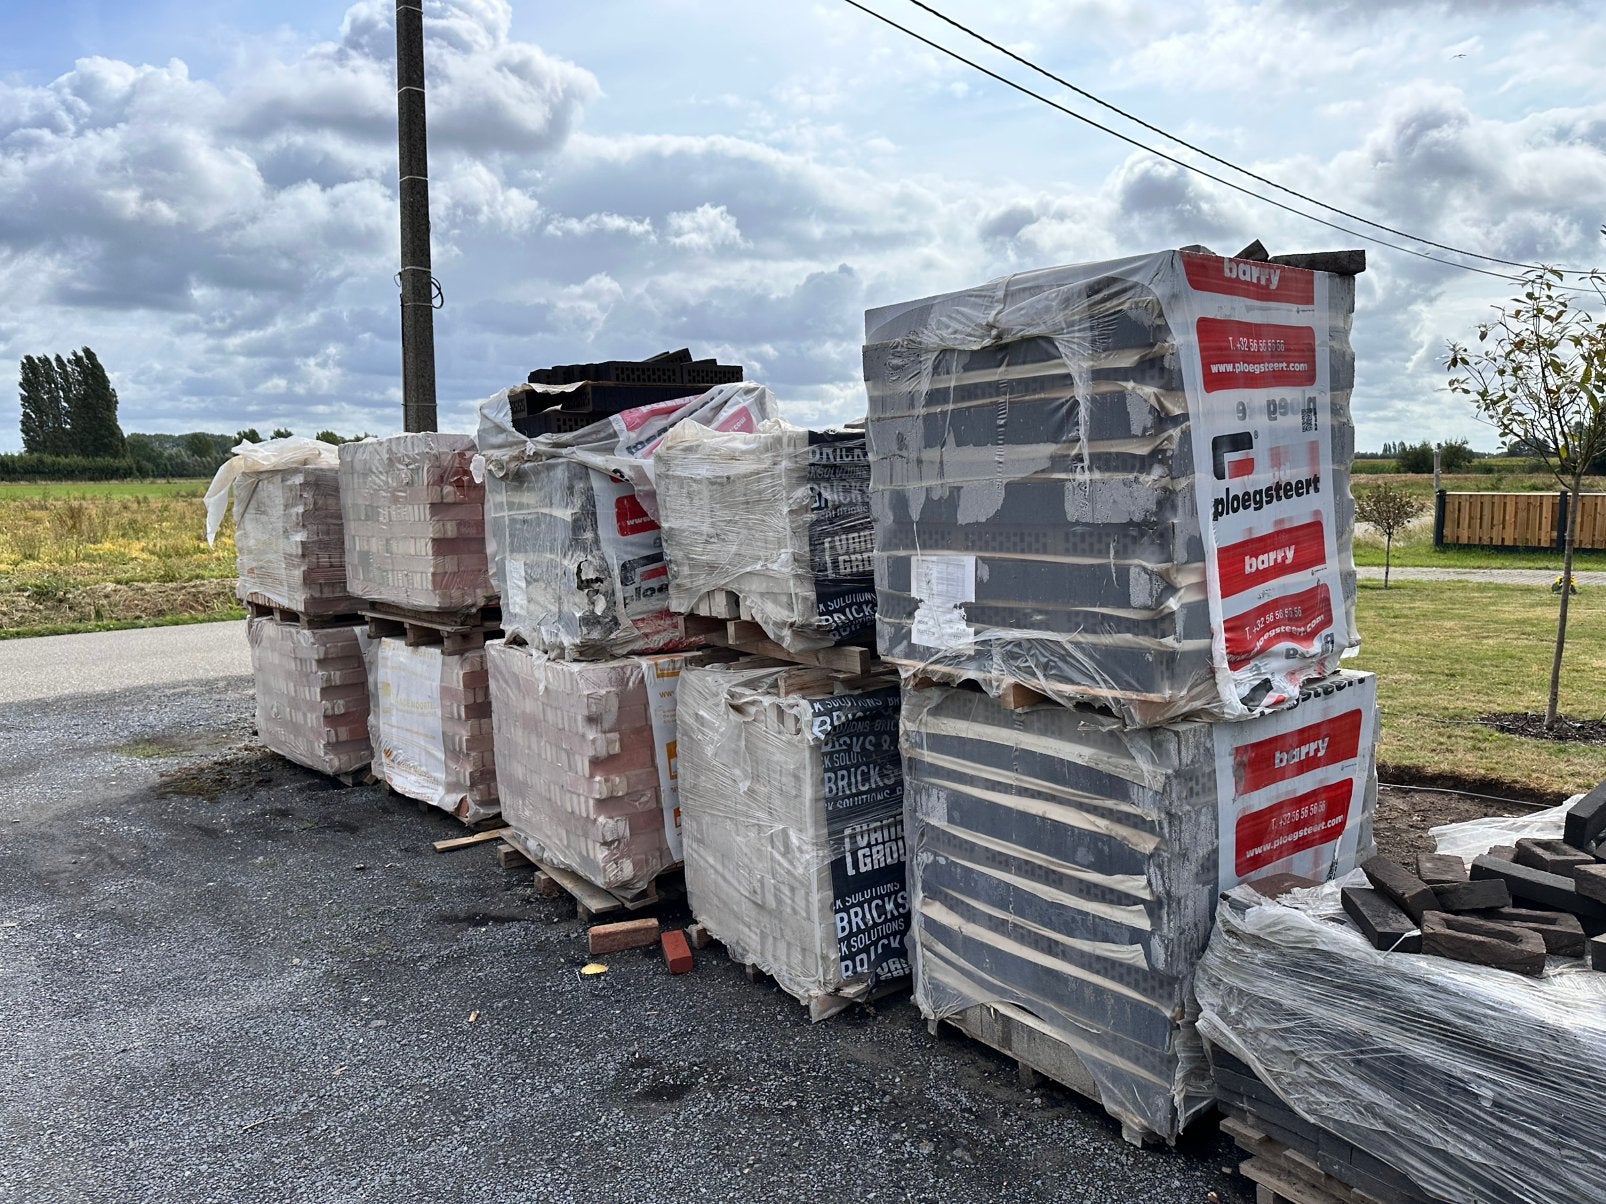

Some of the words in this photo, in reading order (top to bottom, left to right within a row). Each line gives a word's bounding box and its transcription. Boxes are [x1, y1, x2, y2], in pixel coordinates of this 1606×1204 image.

[1223, 257, 1281, 290] barry
[1229, 336, 1236, 351] T.
[1237, 338, 1248, 351] +32
[1250, 339, 1258, 351] 56
[1259, 339, 1267, 351] 56
[1210, 361, 1308, 374] www.ploegsteert.com
[1213, 474, 1320, 521] ploegsteert
[1244, 544, 1295, 575] barry
[1252, 617, 1264, 634] +32
[1265, 612, 1274, 624] 56
[1275, 608, 1284, 621] 56
[1274, 737, 1330, 769] barry
[1291, 809, 1300, 823] 56
[1300, 805, 1309, 819] 56
[1245, 814, 1345, 859] www.ploegsteert.com
[834, 890, 909, 939] BRICKS
[850, 918, 905, 952] SOLUTIONS
